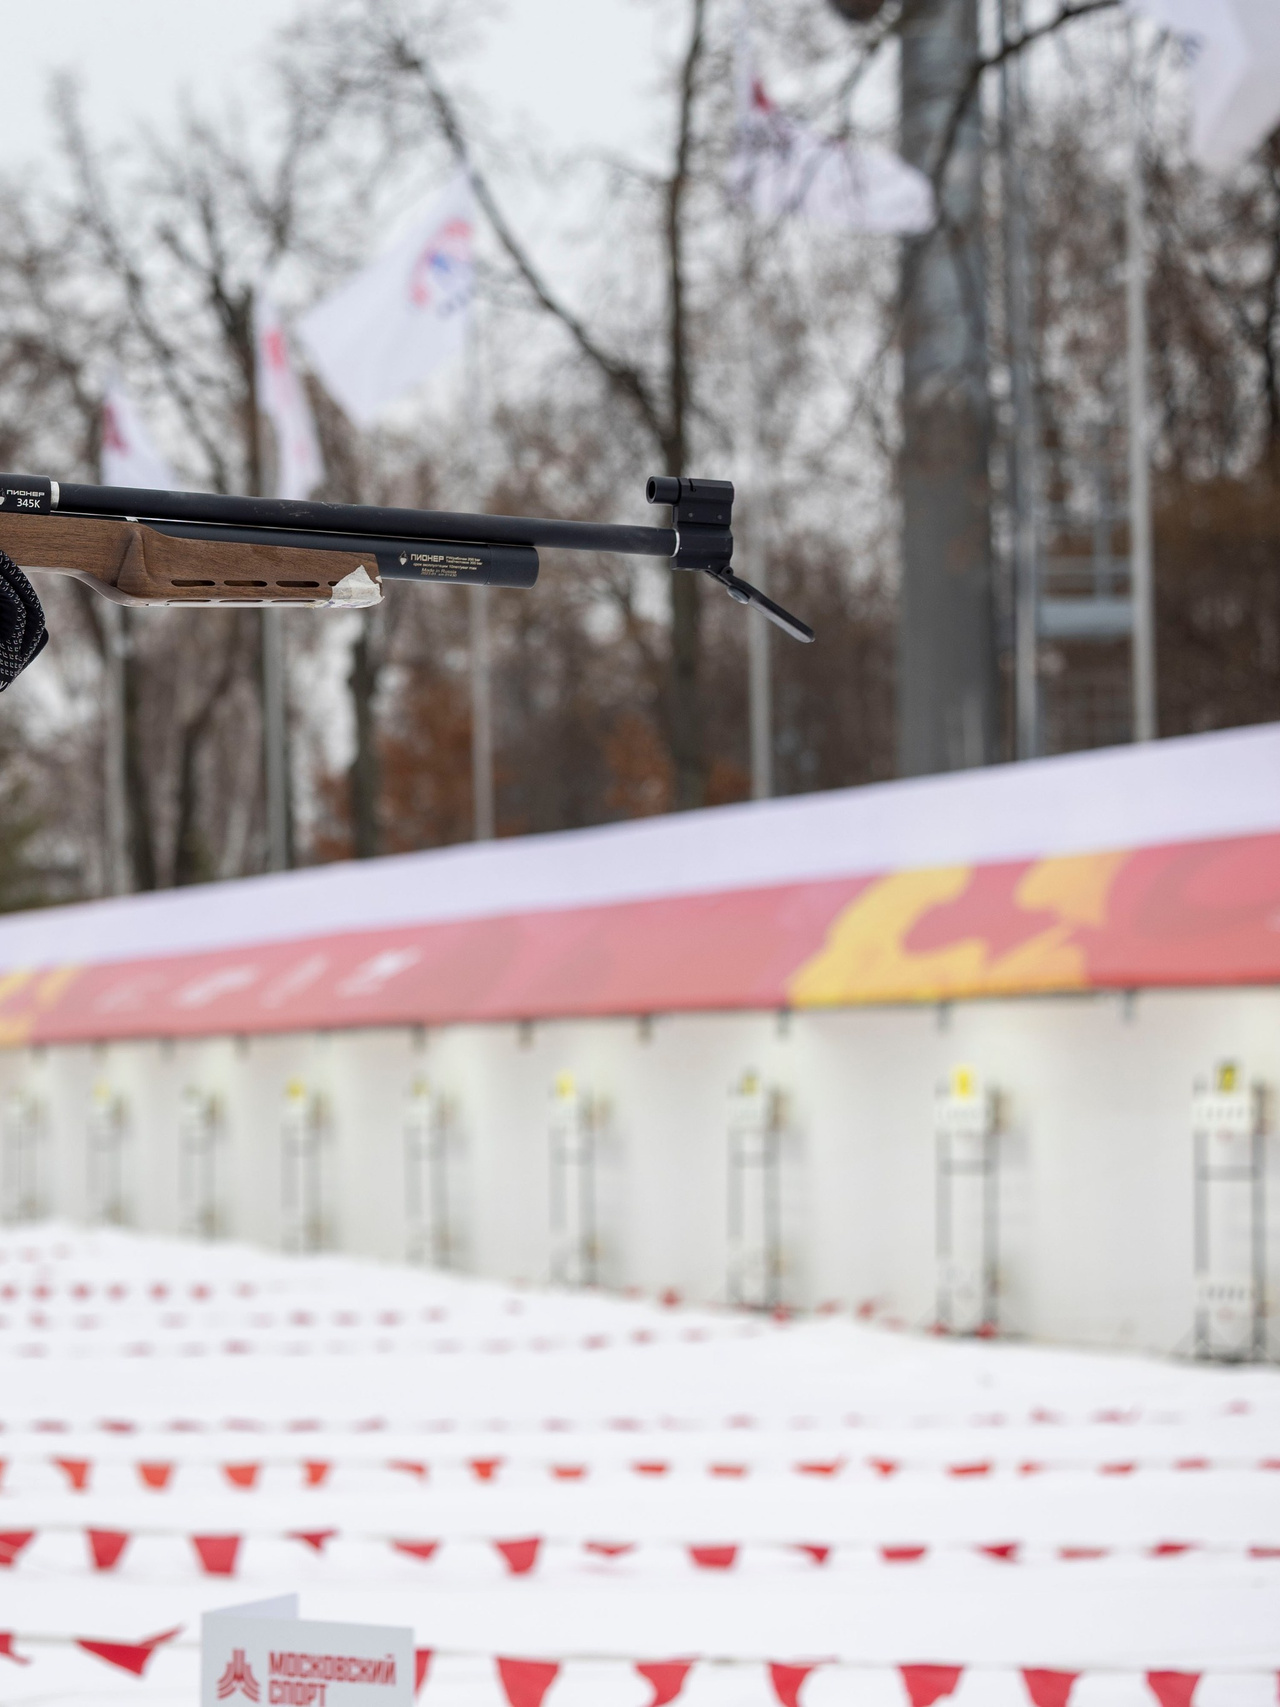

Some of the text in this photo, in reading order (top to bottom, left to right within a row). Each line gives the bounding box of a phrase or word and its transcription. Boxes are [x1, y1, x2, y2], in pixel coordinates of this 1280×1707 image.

[6, 489, 45, 497] ПИОНЕР
[16, 498, 41, 509] 345K
[410, 553, 445, 562] ПИОНЕР
[268, 1652, 396, 1686] МОСКОВСКИЙ
[268, 1679, 326, 1707] СПОРТ
